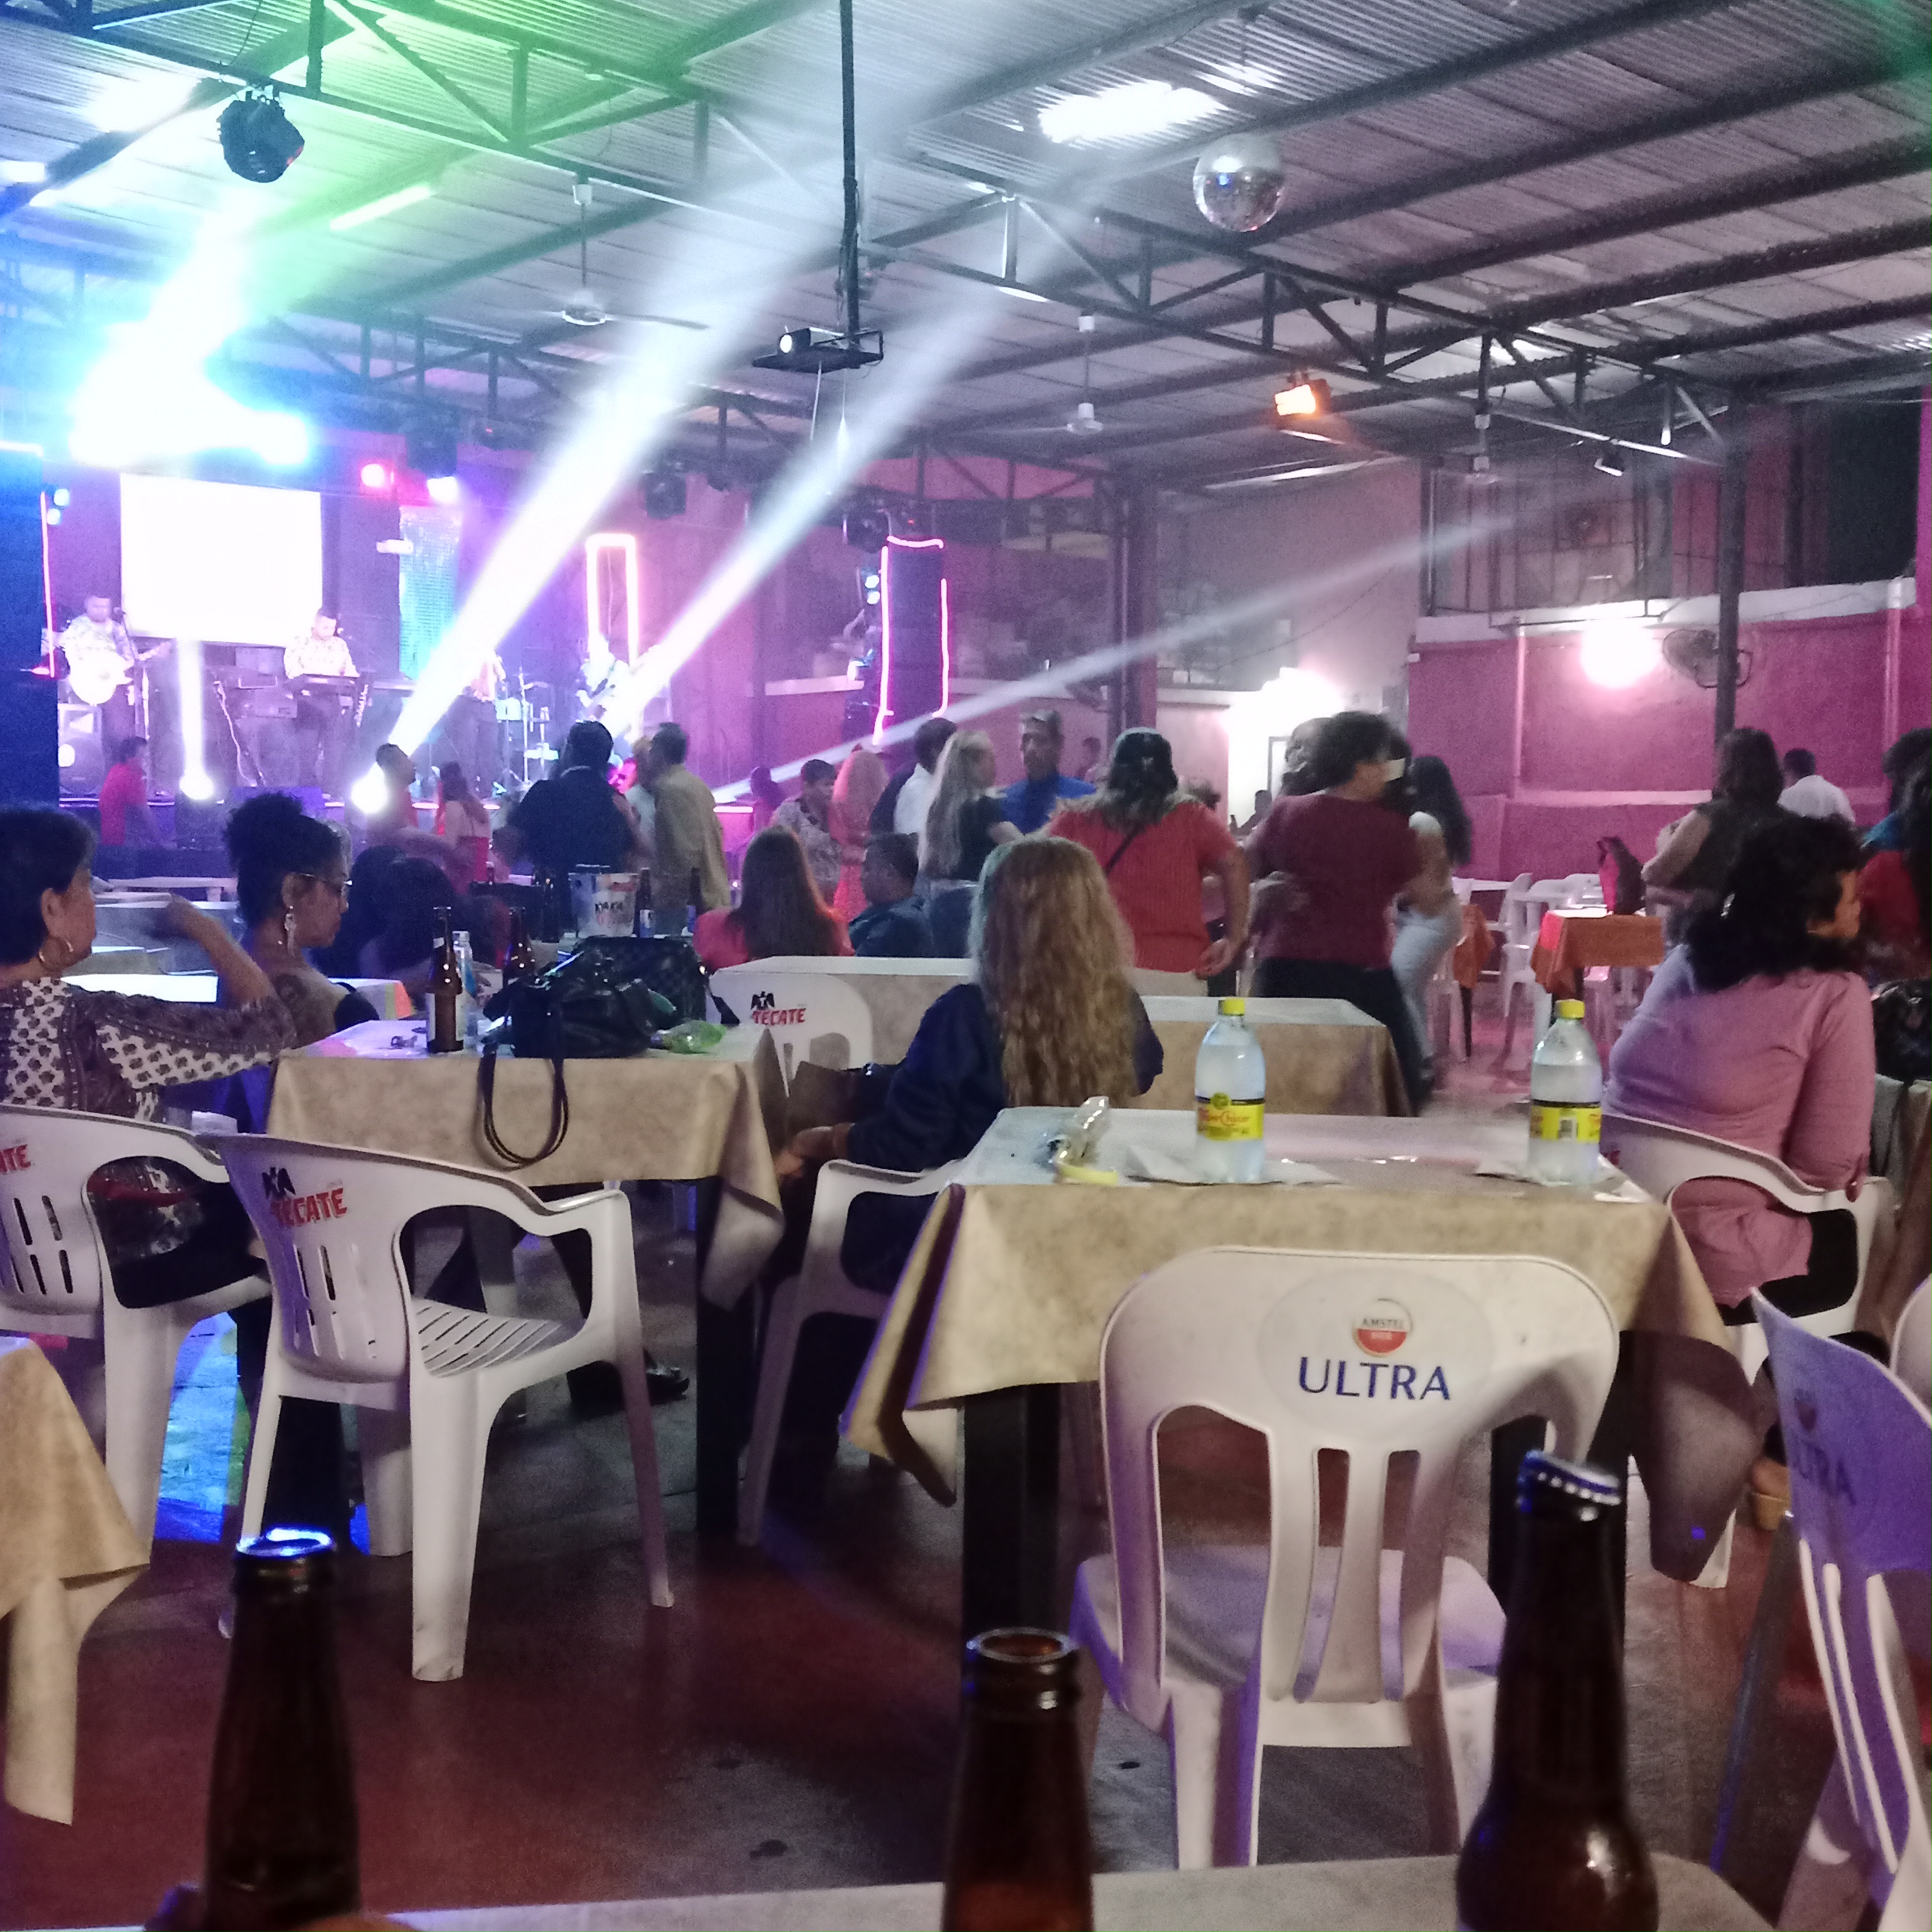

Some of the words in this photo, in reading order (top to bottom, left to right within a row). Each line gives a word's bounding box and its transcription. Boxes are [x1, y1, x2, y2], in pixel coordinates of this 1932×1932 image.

[751, 1008, 806, 1026] TECATE
[270, 1188, 347, 1227] TECATE
[1362, 1318, 1405, 1328] AMSTEL
[1299, 1356, 1451, 1400] ULTRA
